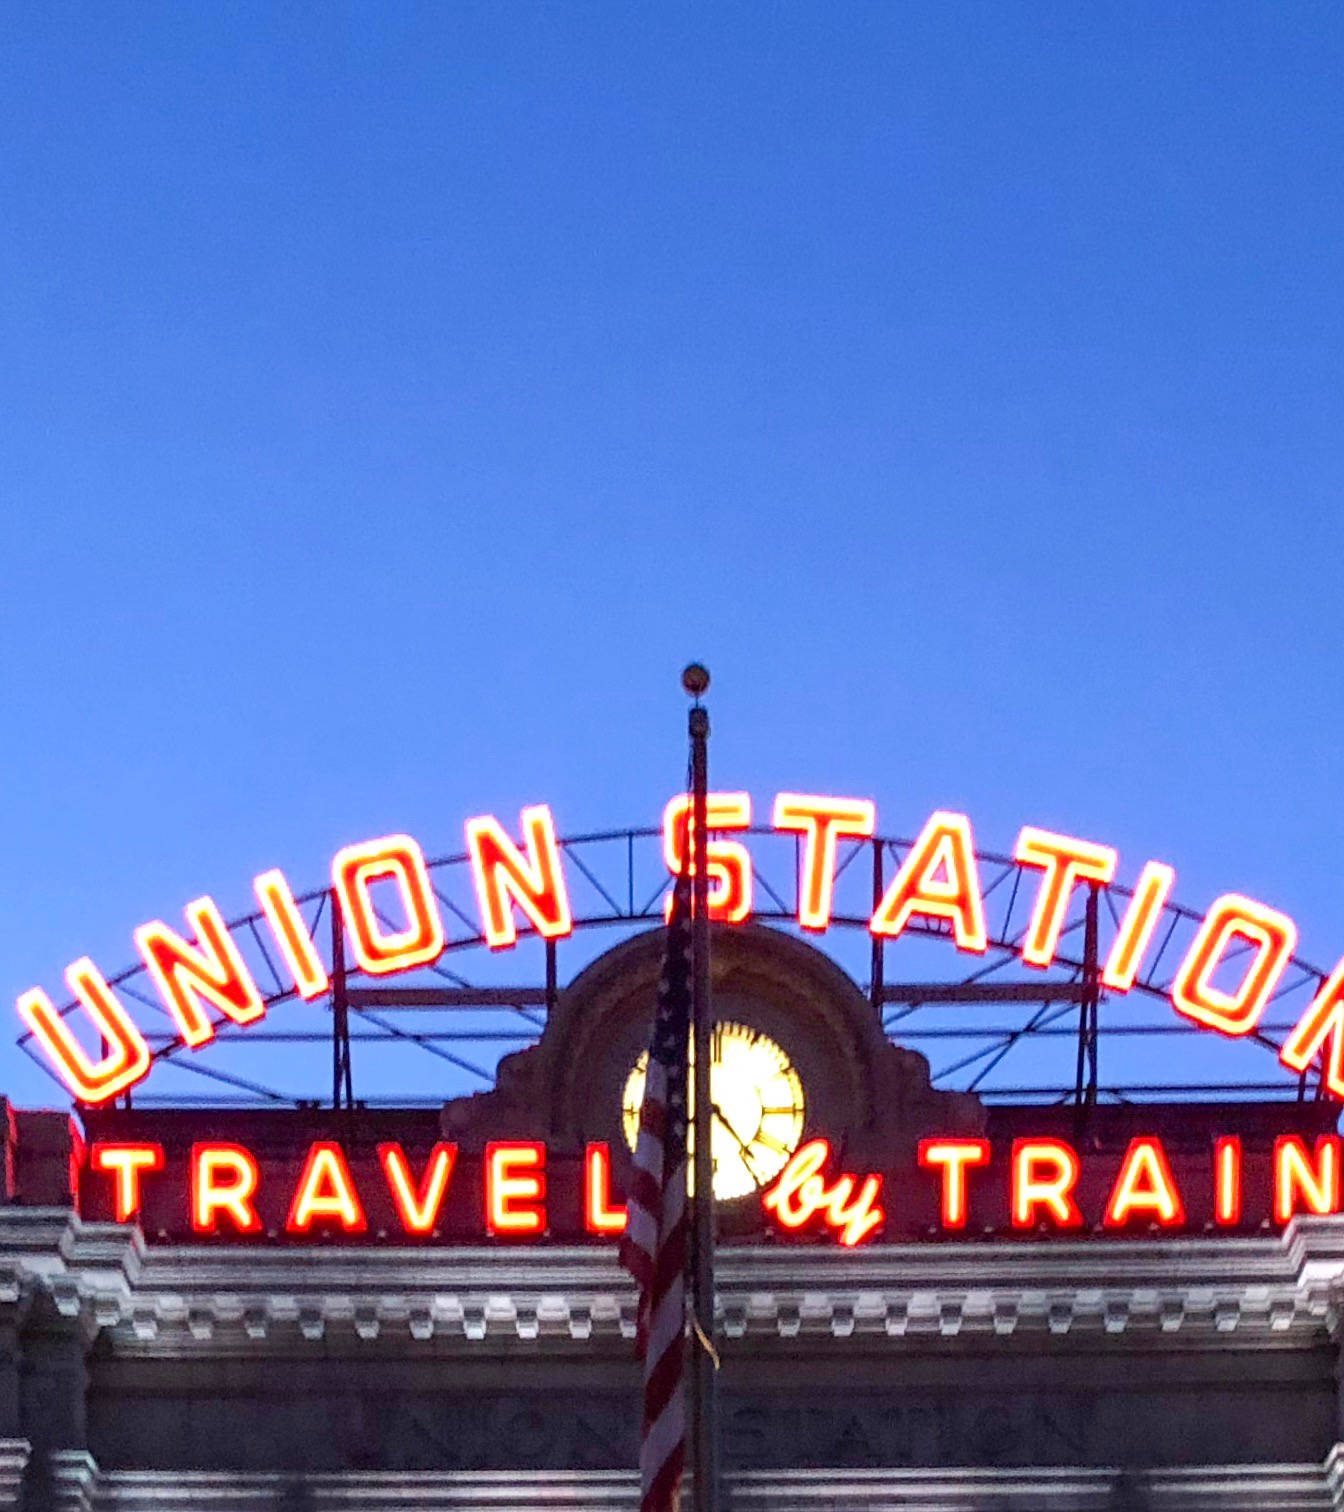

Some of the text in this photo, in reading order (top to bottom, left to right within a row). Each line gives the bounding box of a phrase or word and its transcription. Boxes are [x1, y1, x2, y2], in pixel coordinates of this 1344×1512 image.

[17, 804, 573, 1105] UNION
[91, 1134, 1344, 1246] TRAVEL by TRAIN
